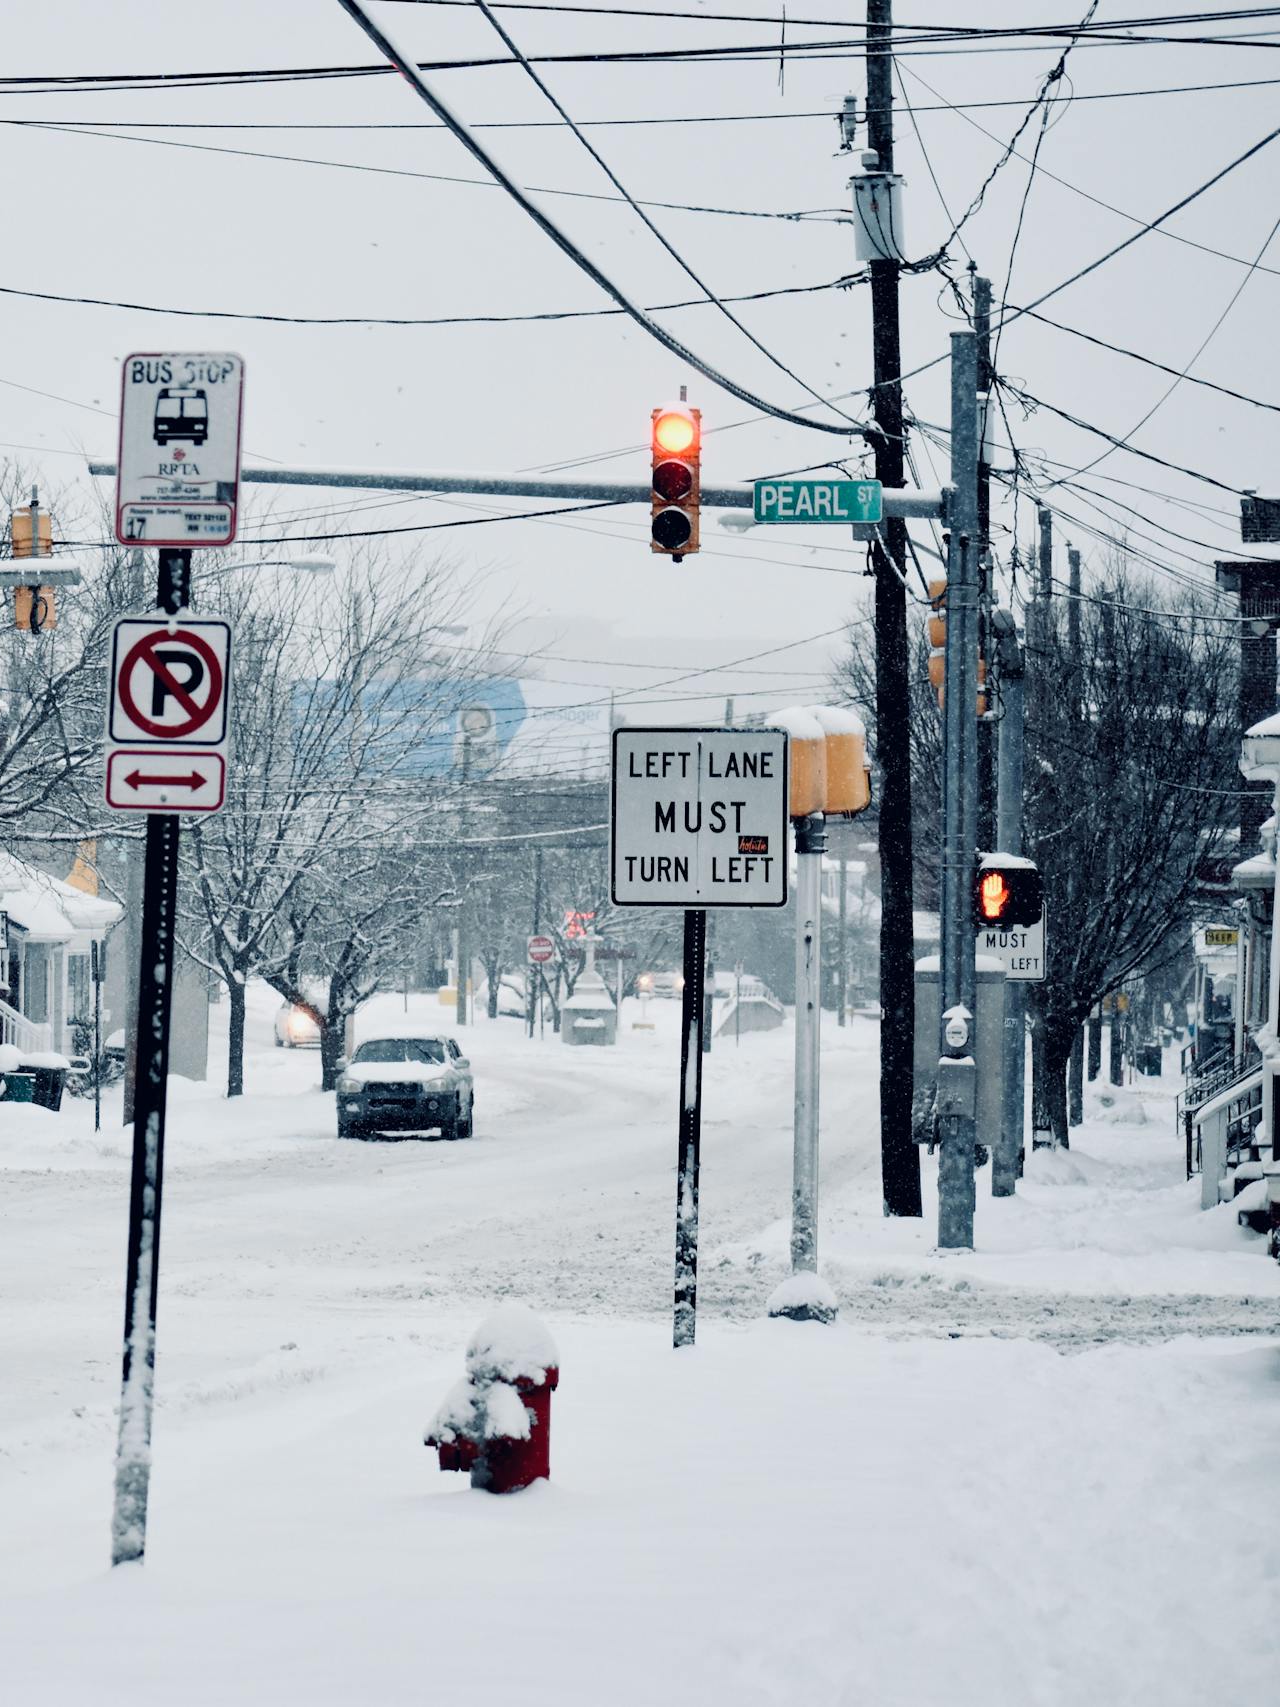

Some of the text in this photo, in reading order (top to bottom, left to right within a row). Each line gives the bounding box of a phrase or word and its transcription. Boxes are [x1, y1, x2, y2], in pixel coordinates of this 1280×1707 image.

[132, 361, 234, 384] BUS STOP
[760, 485, 874, 516] PEARL ST
[126, 517, 146, 539] 17
[629, 752, 774, 778] LEFT LANE
[655, 801, 746, 833] MUST
[625, 857, 773, 883] TURN LEFT
[986, 933, 1027, 948] MUST
[1011, 958, 1039, 970] LEFT
